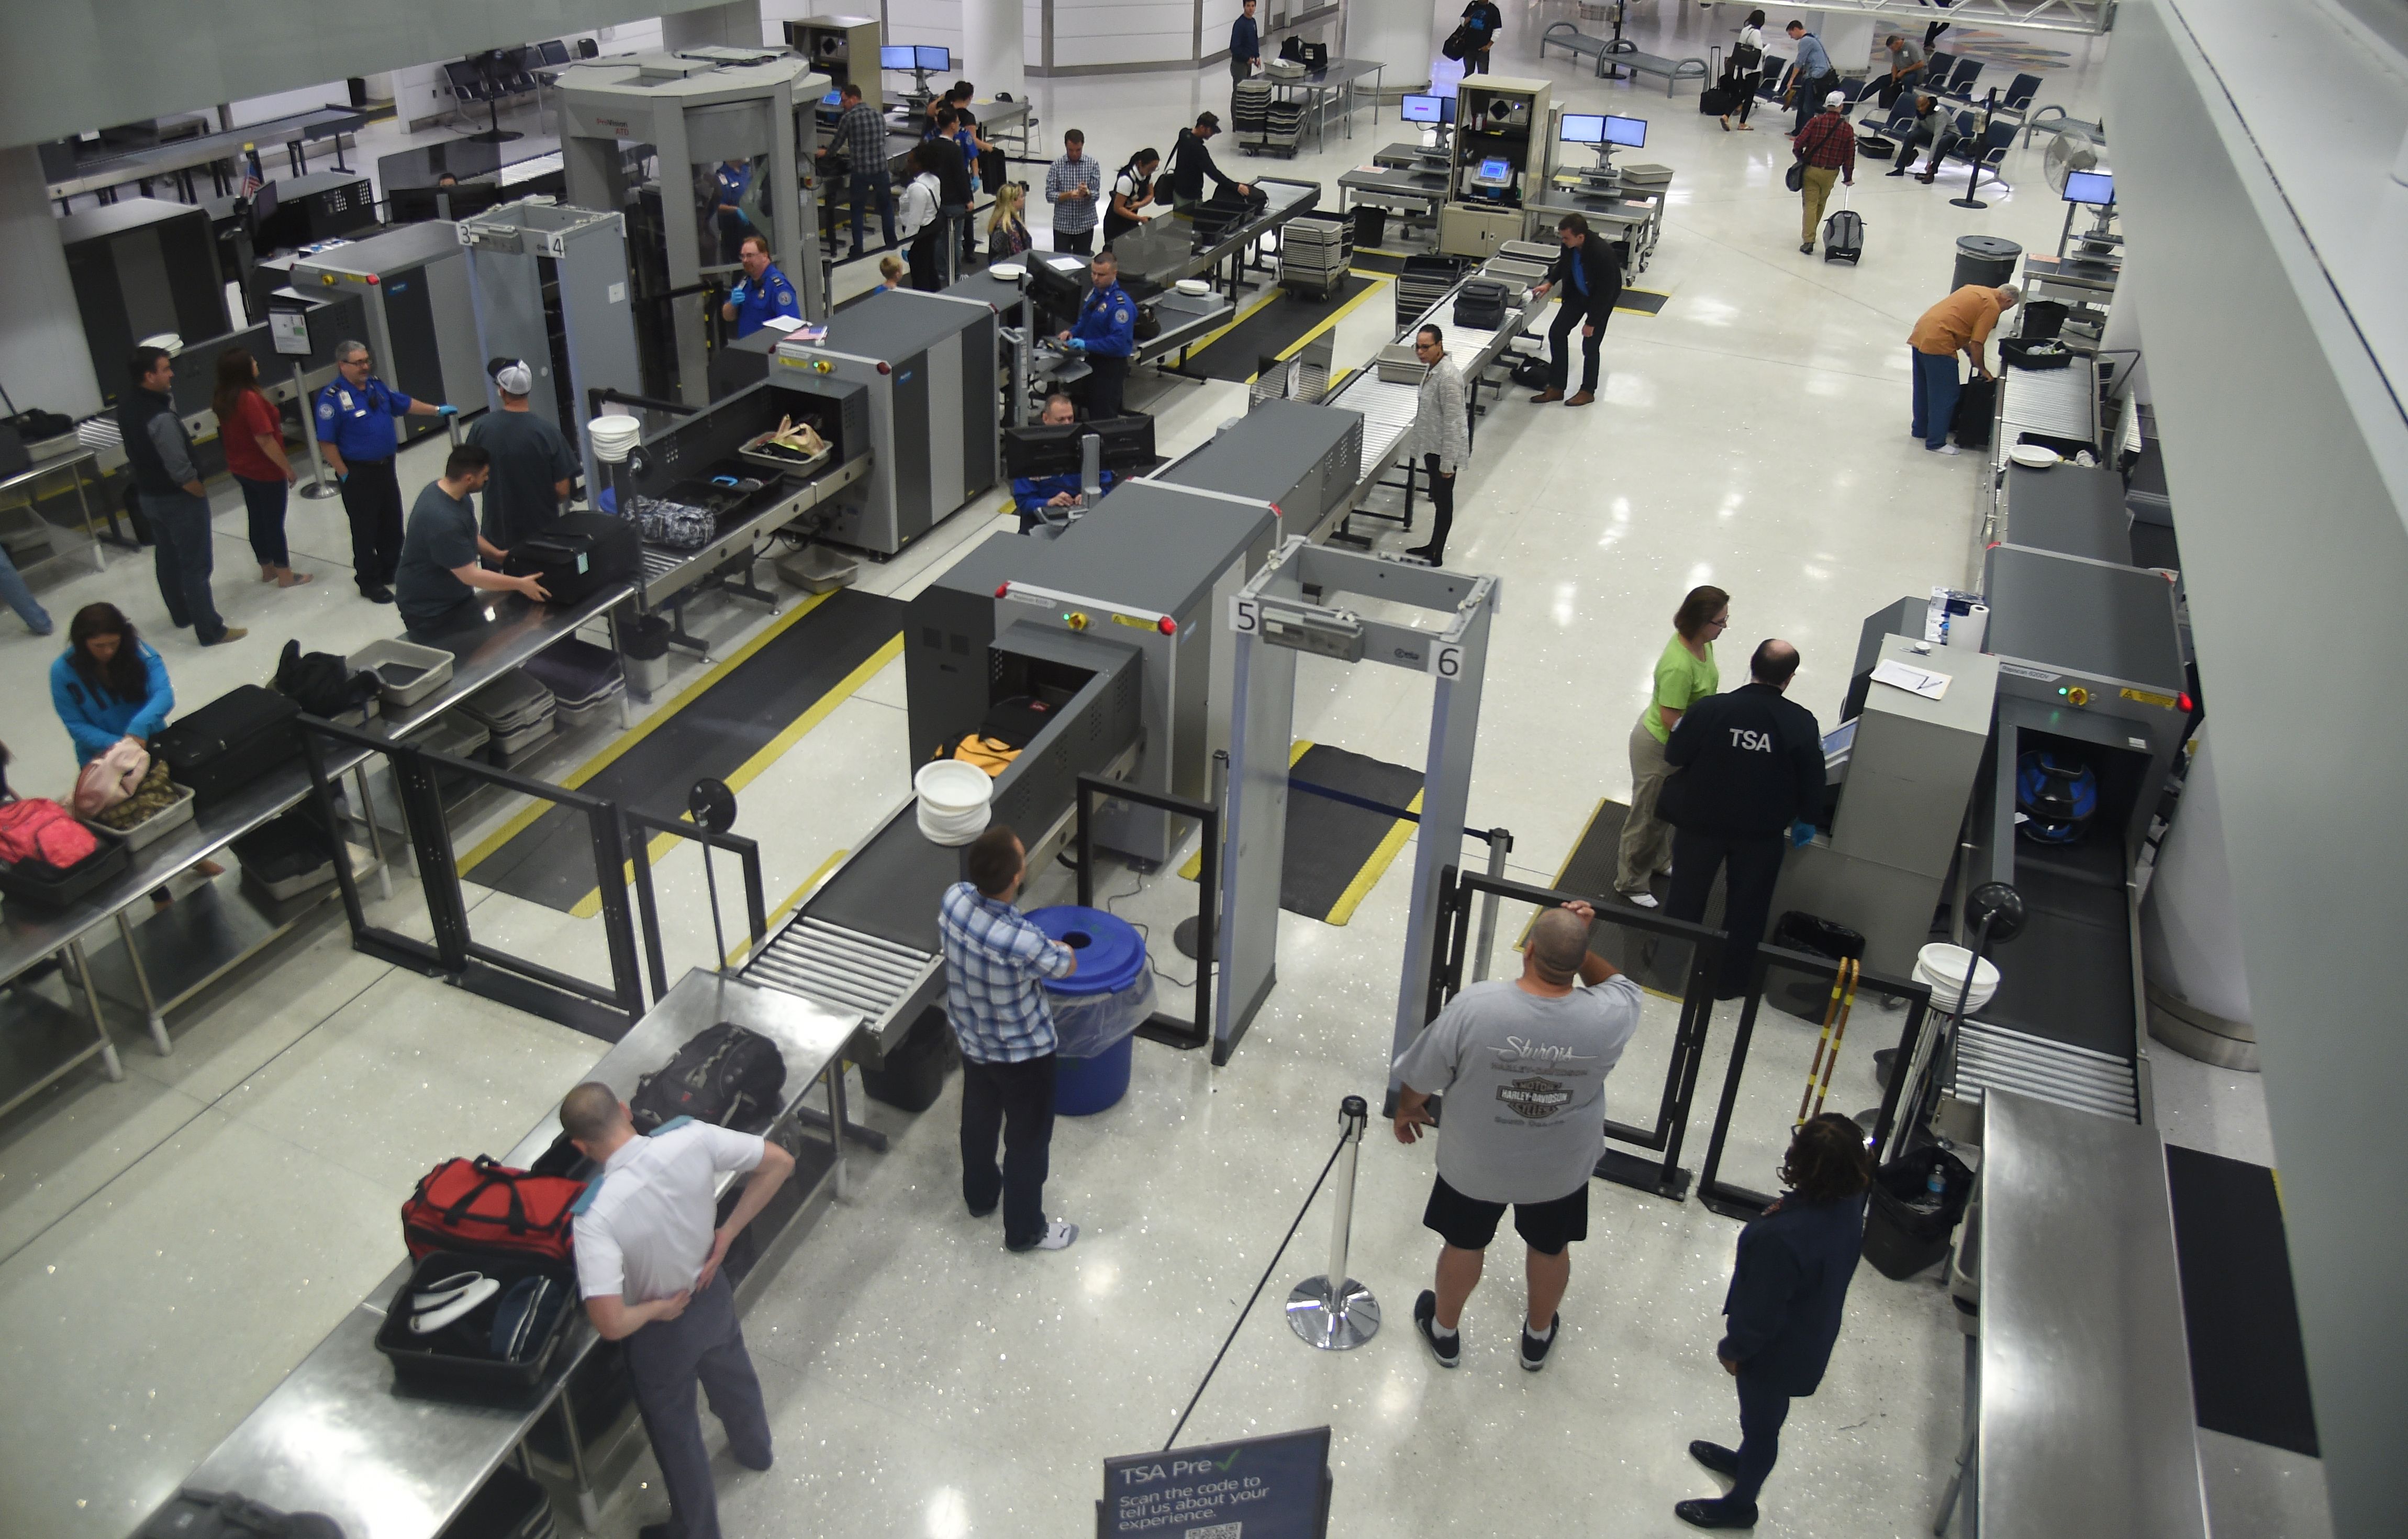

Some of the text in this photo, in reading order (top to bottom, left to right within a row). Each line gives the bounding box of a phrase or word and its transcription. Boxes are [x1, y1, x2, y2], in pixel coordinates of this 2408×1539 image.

[461, 226, 471, 244] 3
[553, 238, 564, 255] 4
[1238, 602, 1255, 630] 5
[1439, 648, 1458, 676] 6
[1729, 728, 1771, 753] TSA
[1487, 1035, 1598, 1063] Sturgis
[1501, 1088, 1568, 1103] HARLEY-DAVIDSON
[1120, 1459, 1212, 1484] TSA Pre
[1120, 1477, 1261, 1507] Scan the code to
[1120, 1487, 1270, 1519] tell us about your
[1119, 1508, 1217, 1530] experience.
